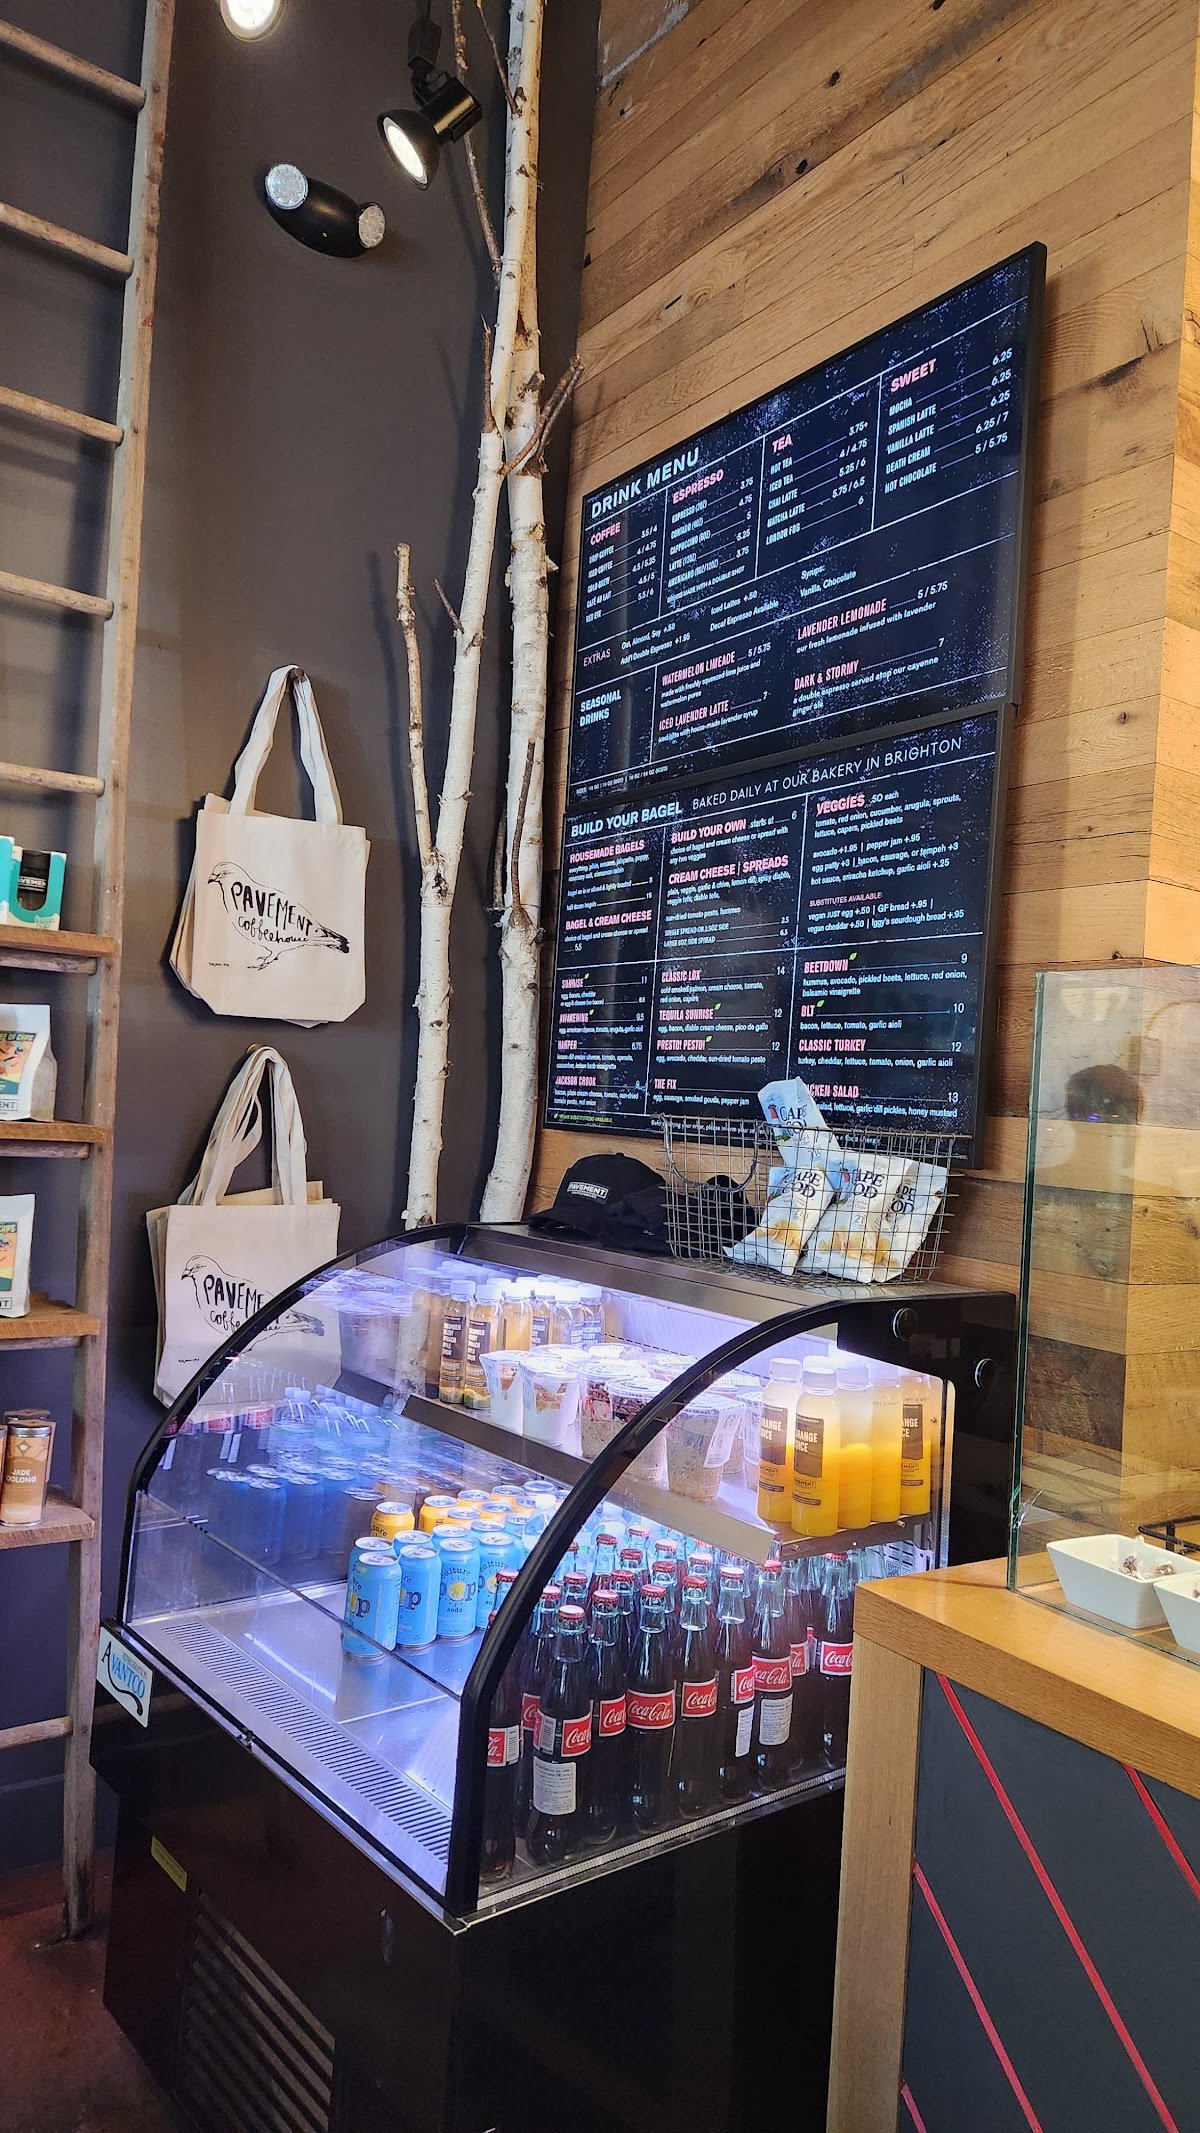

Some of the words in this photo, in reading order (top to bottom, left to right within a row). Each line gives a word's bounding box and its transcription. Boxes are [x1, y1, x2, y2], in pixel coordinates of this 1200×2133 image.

[889, 397, 912, 416] MOCHA
[992, 348, 1012, 366] 6.25
[890, 359, 936, 392] SWEET
[888, 415, 915, 435] SPANISH
[916, 404, 936, 421] LATTE
[991, 369, 1011, 387] 6.25
[887, 434, 913, 454] VANILLA
[914, 424, 934, 441] LATTE
[990, 390, 1010, 407] 6.25
[770, 462, 780, 474] HOT
[782, 456, 792, 469] TEA
[848, 419, 868, 436] 3.75+
[771, 433, 792, 453] TEA
[885, 457, 906, 474] DEATH
[907, 446, 930, 464] CREAM
[975, 418, 995, 434] 6.25
[884, 479, 897, 493] HOT
[899, 463, 936, 487] CHOCOLATE
[988, 432, 1007, 448] 5.75
[591, 479, 641, 518] DRINK
[647, 448, 698, 489] MENU
[672, 469, 724, 504] ESPRESSO
[769, 479, 782, 492] ICED
[783, 473, 793, 486] TEA
[768, 496, 781, 510] CHAI
[782, 488, 797, 503] LATTE
[767, 511, 788, 527] MATCHA
[789, 503, 805, 517] LATTE
[590, 522, 620, 545] COFFEE
[766, 528, 787, 545] LONDON
[788, 522, 800, 535] FOG
[801, 563, 825, 580] Syrups:
[800, 582, 821, 597] Vanilla,
[822, 570, 856, 589] Chocolate
[796, 645, 807, 653] our
[808, 637, 825, 649] fresh
[825, 627, 858, 643] lemonade
[859, 617, 885, 632] infused
[887, 612, 902, 623] with
[904, 601, 936, 617] lavender
[797, 615, 841, 639] LAVENDER
[840, 599, 886, 625] LEMONADE
[583, 649, 610, 666] EXTRAS
[661, 662, 704, 686] WATERMELON
[705, 652, 735, 671] LIMEADE
[794, 674, 815, 690] DARK
[817, 672, 823, 683] &
[825, 660, 859, 680] STORMY
[798, 689, 820, 702] double
[821, 682, 849, 696] espresso
[851, 673, 873, 686] served
[875, 668, 891, 681] atop
[893, 665, 905, 674] our
[907, 656, 938, 672] cayenne
[580, 689, 621, 712] SEASONAL
[579, 708, 609, 726] DRINKS
[658, 717, 673, 731] ICED
[674, 707, 707, 726] LAVENDER
[709, 700, 728, 716] LATTE
[571, 819, 603, 837] BUILD
[605, 811, 638, 829] YOUR
[641, 800, 682, 821] BAGEL
[692, 792, 726, 810] BAKED
[730, 784, 761, 801] DAILY
[764, 780, 778, 793] AT
[782, 772, 808, 790] OUR
[812, 760, 861, 782] BAKERY
[865, 755, 879, 770] IN
[885, 737, 961, 766] BRIGHTON
[815, 816, 837, 828] tomato,
[838, 814, 847, 823] red
[849, 810, 868, 822] onion,
[869, 804, 902, 818] cucumber,
[904, 798, 931, 813] arugula,
[932, 793, 961, 808] sprouts,
[816, 794, 865, 815] VEGGIES
[884, 790, 899, 800] each
[671, 829, 697, 843] BUILD
[698, 823, 723, 838] YOUR
[724, 819, 746, 833] OWN
[749, 817, 766, 828] starts
[814, 827, 836, 839] lettuce,
[836, 824, 859, 835] capers,
[860, 818, 883, 831] pickled
[884, 815, 903, 826] beets
[615, 839, 645, 854] BAGELS
[813, 847, 837, 858] avocado
[838, 844, 857, 854] +1.95
[668, 870, 698, 884] CREAM
[699, 864, 735, 879] CHEESE
[742, 855, 788, 872] SPREADS
[231, 881, 313, 936] PAVEMENT
[809, 896, 847, 907] SUBSTITUTES
[848, 892, 882, 902] AVAILABLE:
[565, 918, 587, 930] BAGEL
[588, 918, 593, 927] &
[594, 914, 619, 926] CREAM
[620, 910, 651, 923] CHEESE
[661, 970, 687, 982] CLASSIC
[688, 970, 700, 980] LOX
[776, 966, 785, 975] 14
[803, 959, 848, 973] BEETDOWN
[961, 953, 967, 963] 9
[658, 1009, 683, 1020] TEQUILA
[684, 1008, 713, 1019] SUNRISE
[774, 1009, 782, 1017] 12
[801, 1005, 814, 1016] BLT
[952, 1003, 964, 1013] 10
[800, 1022, 819, 1030] bacon,
[820, 1021, 842, 1029] lettuce,
[844, 1021, 867, 1030] tomato,
[868, 1021, 887, 1030] garlic
[888, 1020, 902, 1028] aioli
[656, 1039, 681, 1050] PRESTO!
[683, 1040, 705, 1050] PESTO!
[771, 1042, 780, 1050] 12
[798, 1039, 831, 1051] CLASSIC
[833, 1039, 865, 1051] TURKEY
[950, 1042, 962, 1051] 12
[654, 1079, 665, 1089] THE
[666, 1079, 676, 1089] FIX
[832, 1085, 859, 1097] SALAD
[947, 1092, 958, 1102] 13
[569, 1183, 606, 1196] PAVEMENT
[782, 1183, 816, 1199] COD
[6, 1475, 37, 1483] OOLONG
[101, 1641, 145, 1699] AVANTCO
[627, 1701, 671, 1722] Coca-Cola
